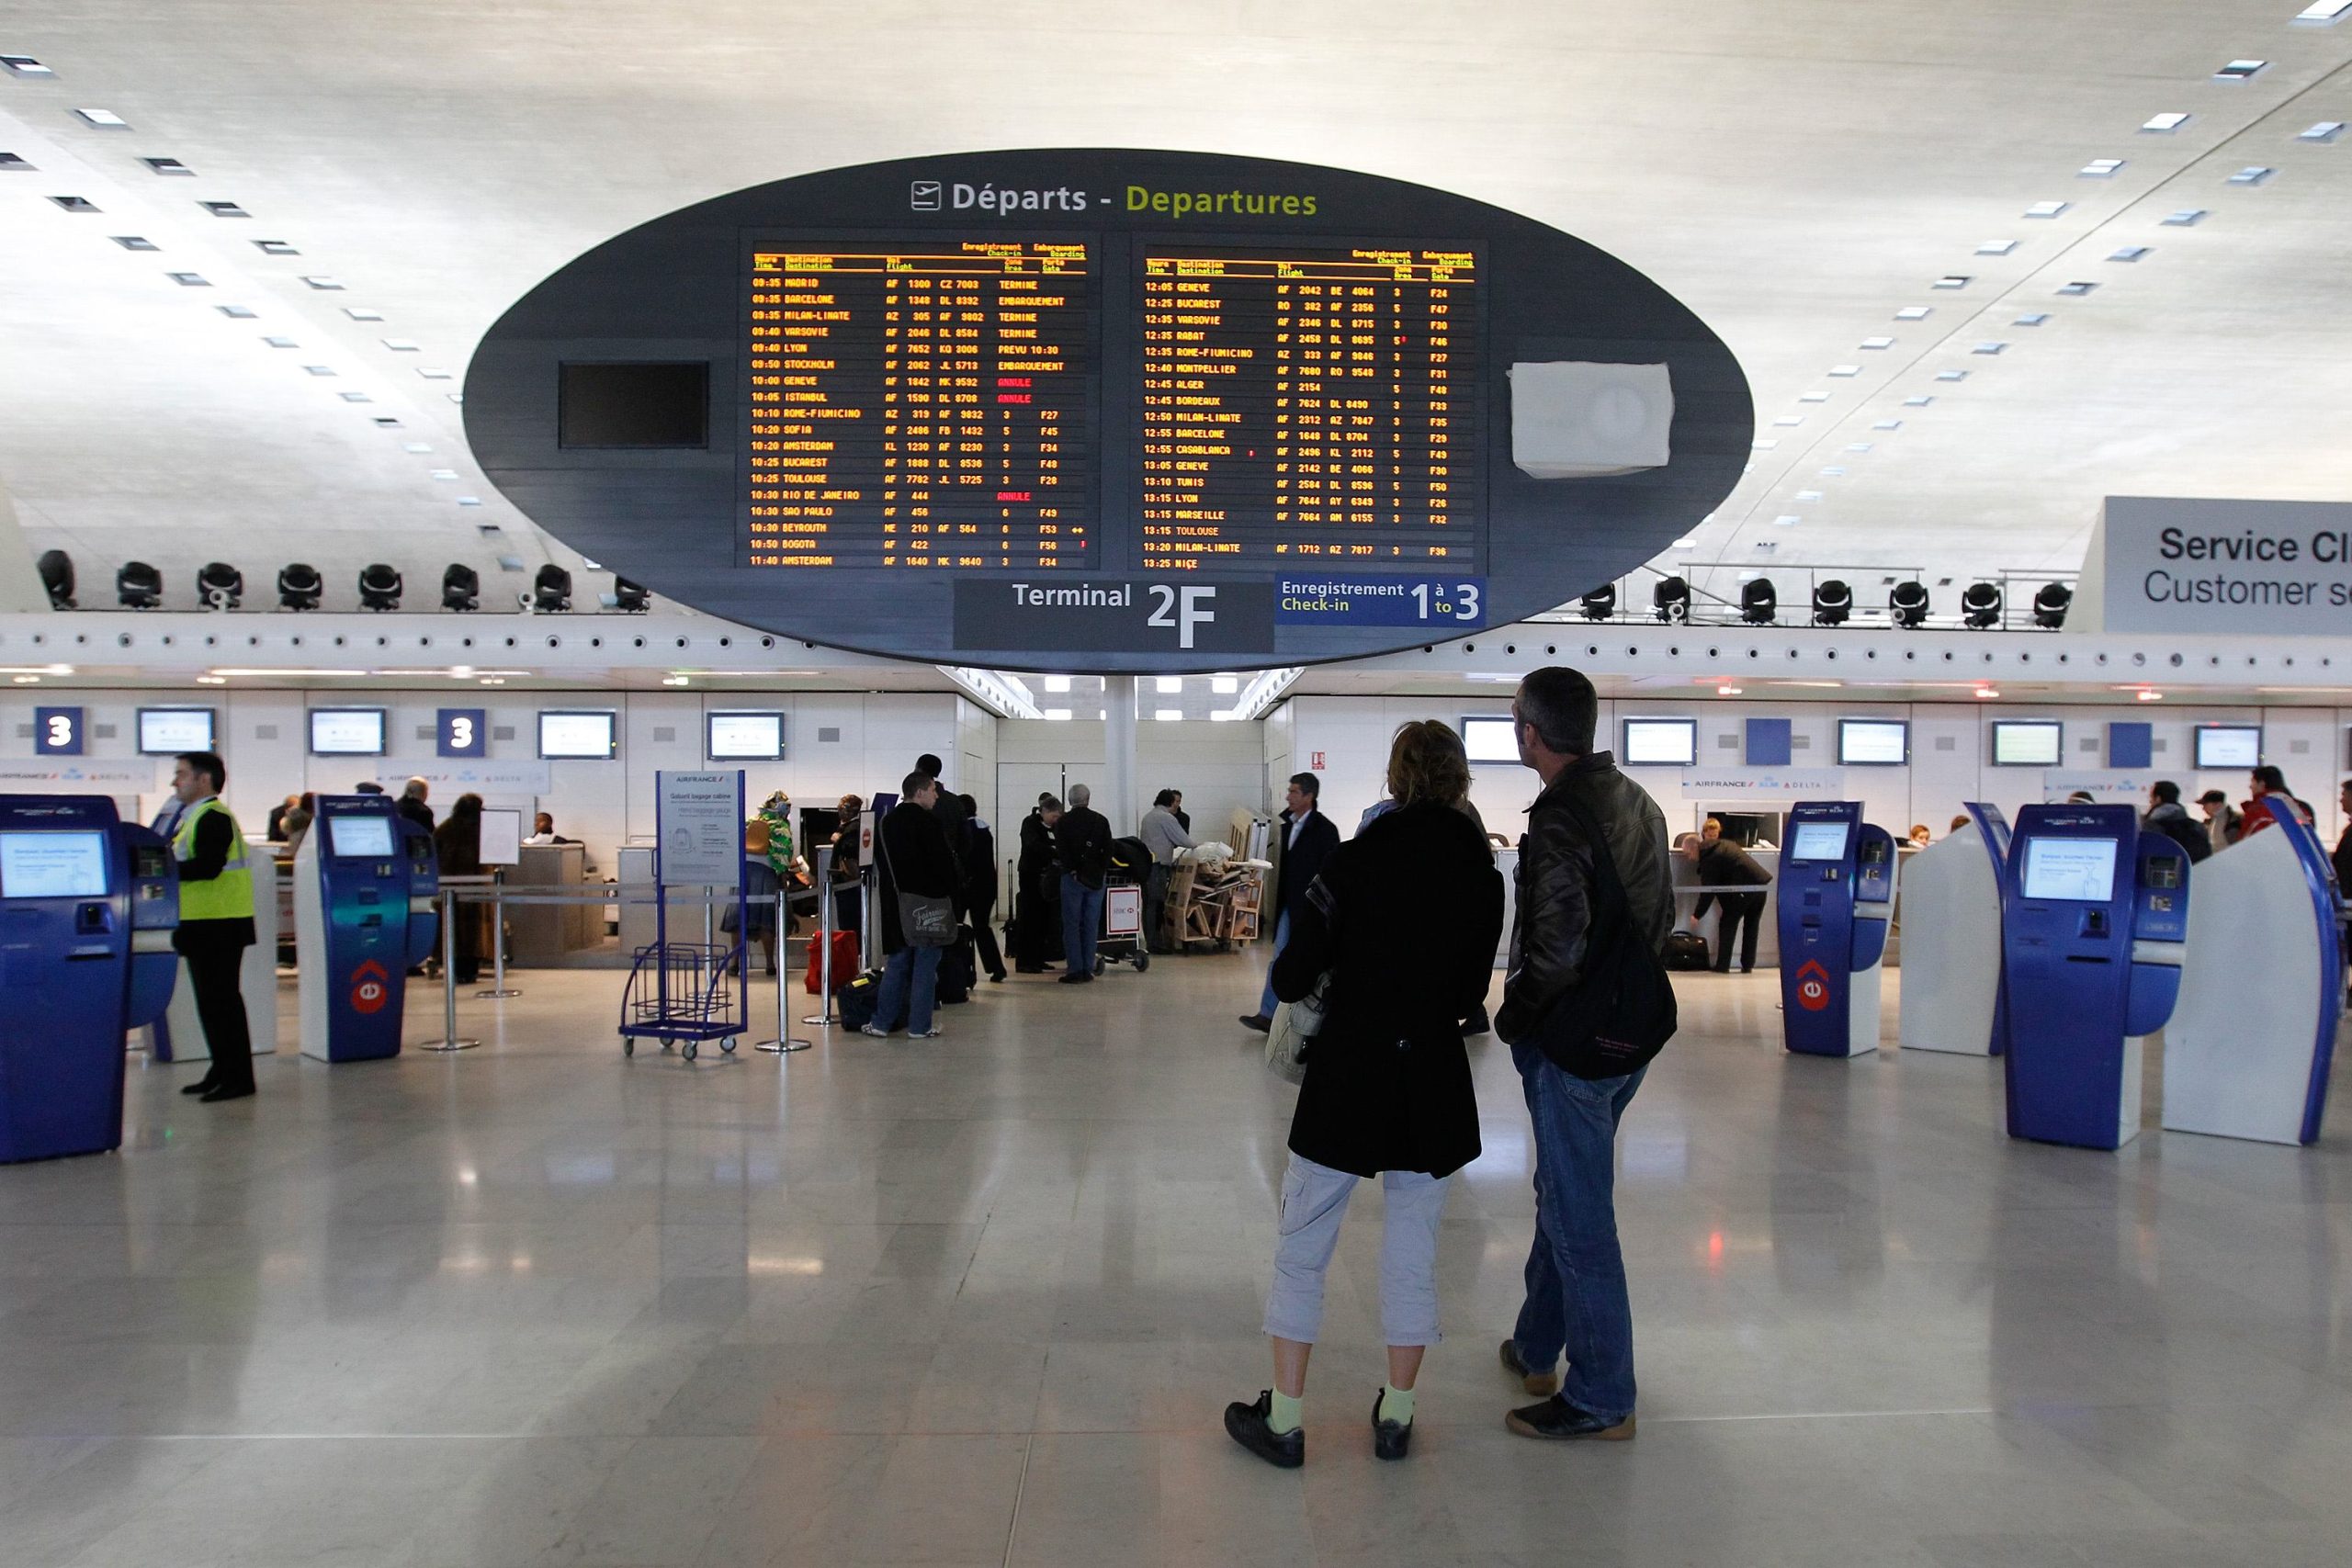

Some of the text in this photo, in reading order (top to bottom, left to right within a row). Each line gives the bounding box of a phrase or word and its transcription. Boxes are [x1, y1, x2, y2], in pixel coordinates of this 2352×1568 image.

[953, 184, 1087, 215] Départs
[1126, 186, 1317, 219] Departures
[752, 278, 1037, 289] 09:35 MADRID TERMINE
[1146, 282, 1173, 291] 12:05
[1176, 283, 1210, 292] GENEVE
[752, 295, 781, 303] 09:35
[785, 295, 834, 304] BARCELONE
[1146, 299, 1173, 308] 12:25
[1177, 299, 1221, 309] BUCAREST
[752, 310, 1037, 321] 09:35 MILAN-LINATE TERMINE
[1146, 315, 1173, 323] 12:35
[1177, 316, 1220, 325] VARSOVIE
[752, 327, 1037, 338] 09:40 VARSOVIE TERMINE
[1146, 331, 1172, 340] 12:35
[1176, 332, 1205, 340] RABAT
[752, 344, 1058, 355] 09:40 LYON PREVU 10:30
[1146, 347, 1172, 355] 12:35
[1177, 348, 1253, 357] ROME-FIUMICINO
[752, 360, 781, 368] 09:50
[784, 360, 835, 369] STOCKHOLM
[1145, 364, 1172, 372] 12:40
[1176, 364, 1237, 374] MONTPELLIER
[752, 376, 780, 385] 10:00
[783, 377, 818, 386] GENEVE
[1145, 379, 1172, 389] 12:45
[1176, 380, 1204, 389] ALGER
[752, 392, 780, 401] 10:05
[786, 392, 827, 401] ISTANBUL
[1145, 396, 1172, 404] 12:45
[1176, 396, 1220, 405] BORDEAUX
[752, 409, 780, 418] 10:10
[784, 409, 861, 418] ROME-FIUMICINO
[1145, 412, 1172, 421] 12:50
[1176, 413, 1241, 423] MILAN-LINATE
[752, 425, 780, 434] 10:20
[783, 425, 813, 434] SOFIA
[1145, 429, 1172, 437] 12:55
[1176, 429, 1225, 438] BARCELONE
[752, 441, 780, 450] 10:20
[783, 441, 834, 451] AMSTERDAM
[1145, 445, 1172, 453] 12:55
[1176, 446, 1231, 455] CASABLANCA
[752, 457, 779, 467] 10:25
[783, 457, 828, 467] BUCAREST
[1145, 461, 1171, 469] 13:05
[1176, 461, 1208, 470] GENEVE
[751, 474, 780, 483] 10:25
[783, 474, 827, 483] TOULOUSE
[1145, 478, 1172, 486] 13:10
[1177, 478, 1204, 487] TUNIS
[752, 491, 779, 500] 10:30
[783, 491, 801, 500] RIO
[804, 491, 817, 500] DE
[820, 491, 860, 500] JANEIRO
[1144, 493, 1173, 502] 13:15
[1175, 494, 1198, 502] LYON
[751, 507, 780, 515] 10:30
[783, 507, 801, 516] SAO
[804, 507, 833, 516] PAULO
[1145, 510, 1171, 518] 13:15
[1176, 511, 1225, 520] MARSEILLE
[751, 523, 780, 532] 10:30
[783, 524, 827, 533] BEYROUTH
[1144, 526, 1218, 536] 13:15 TOULOUSE
[751, 539, 780, 548] 10:50
[783, 539, 818, 549] BOGOTA
[1144, 543, 1172, 551] 13:20
[1175, 543, 1240, 552] MILAN-LINATE
[2160, 527, 2352, 563] Service Cl
[751, 556, 779, 565] 11:40
[783, 556, 834, 565] AMSTERDAM
[1144, 559, 1171, 568] 13:25
[2145, 570, 2352, 606] Customer s
[1282, 581, 1445, 619] Enregistrement 1 à
[1282, 583, 1480, 620] Check-in to 3
[1012, 583, 1216, 649] Terminal 2F
[48, 716, 72, 747] 3
[450, 717, 472, 748] 3
